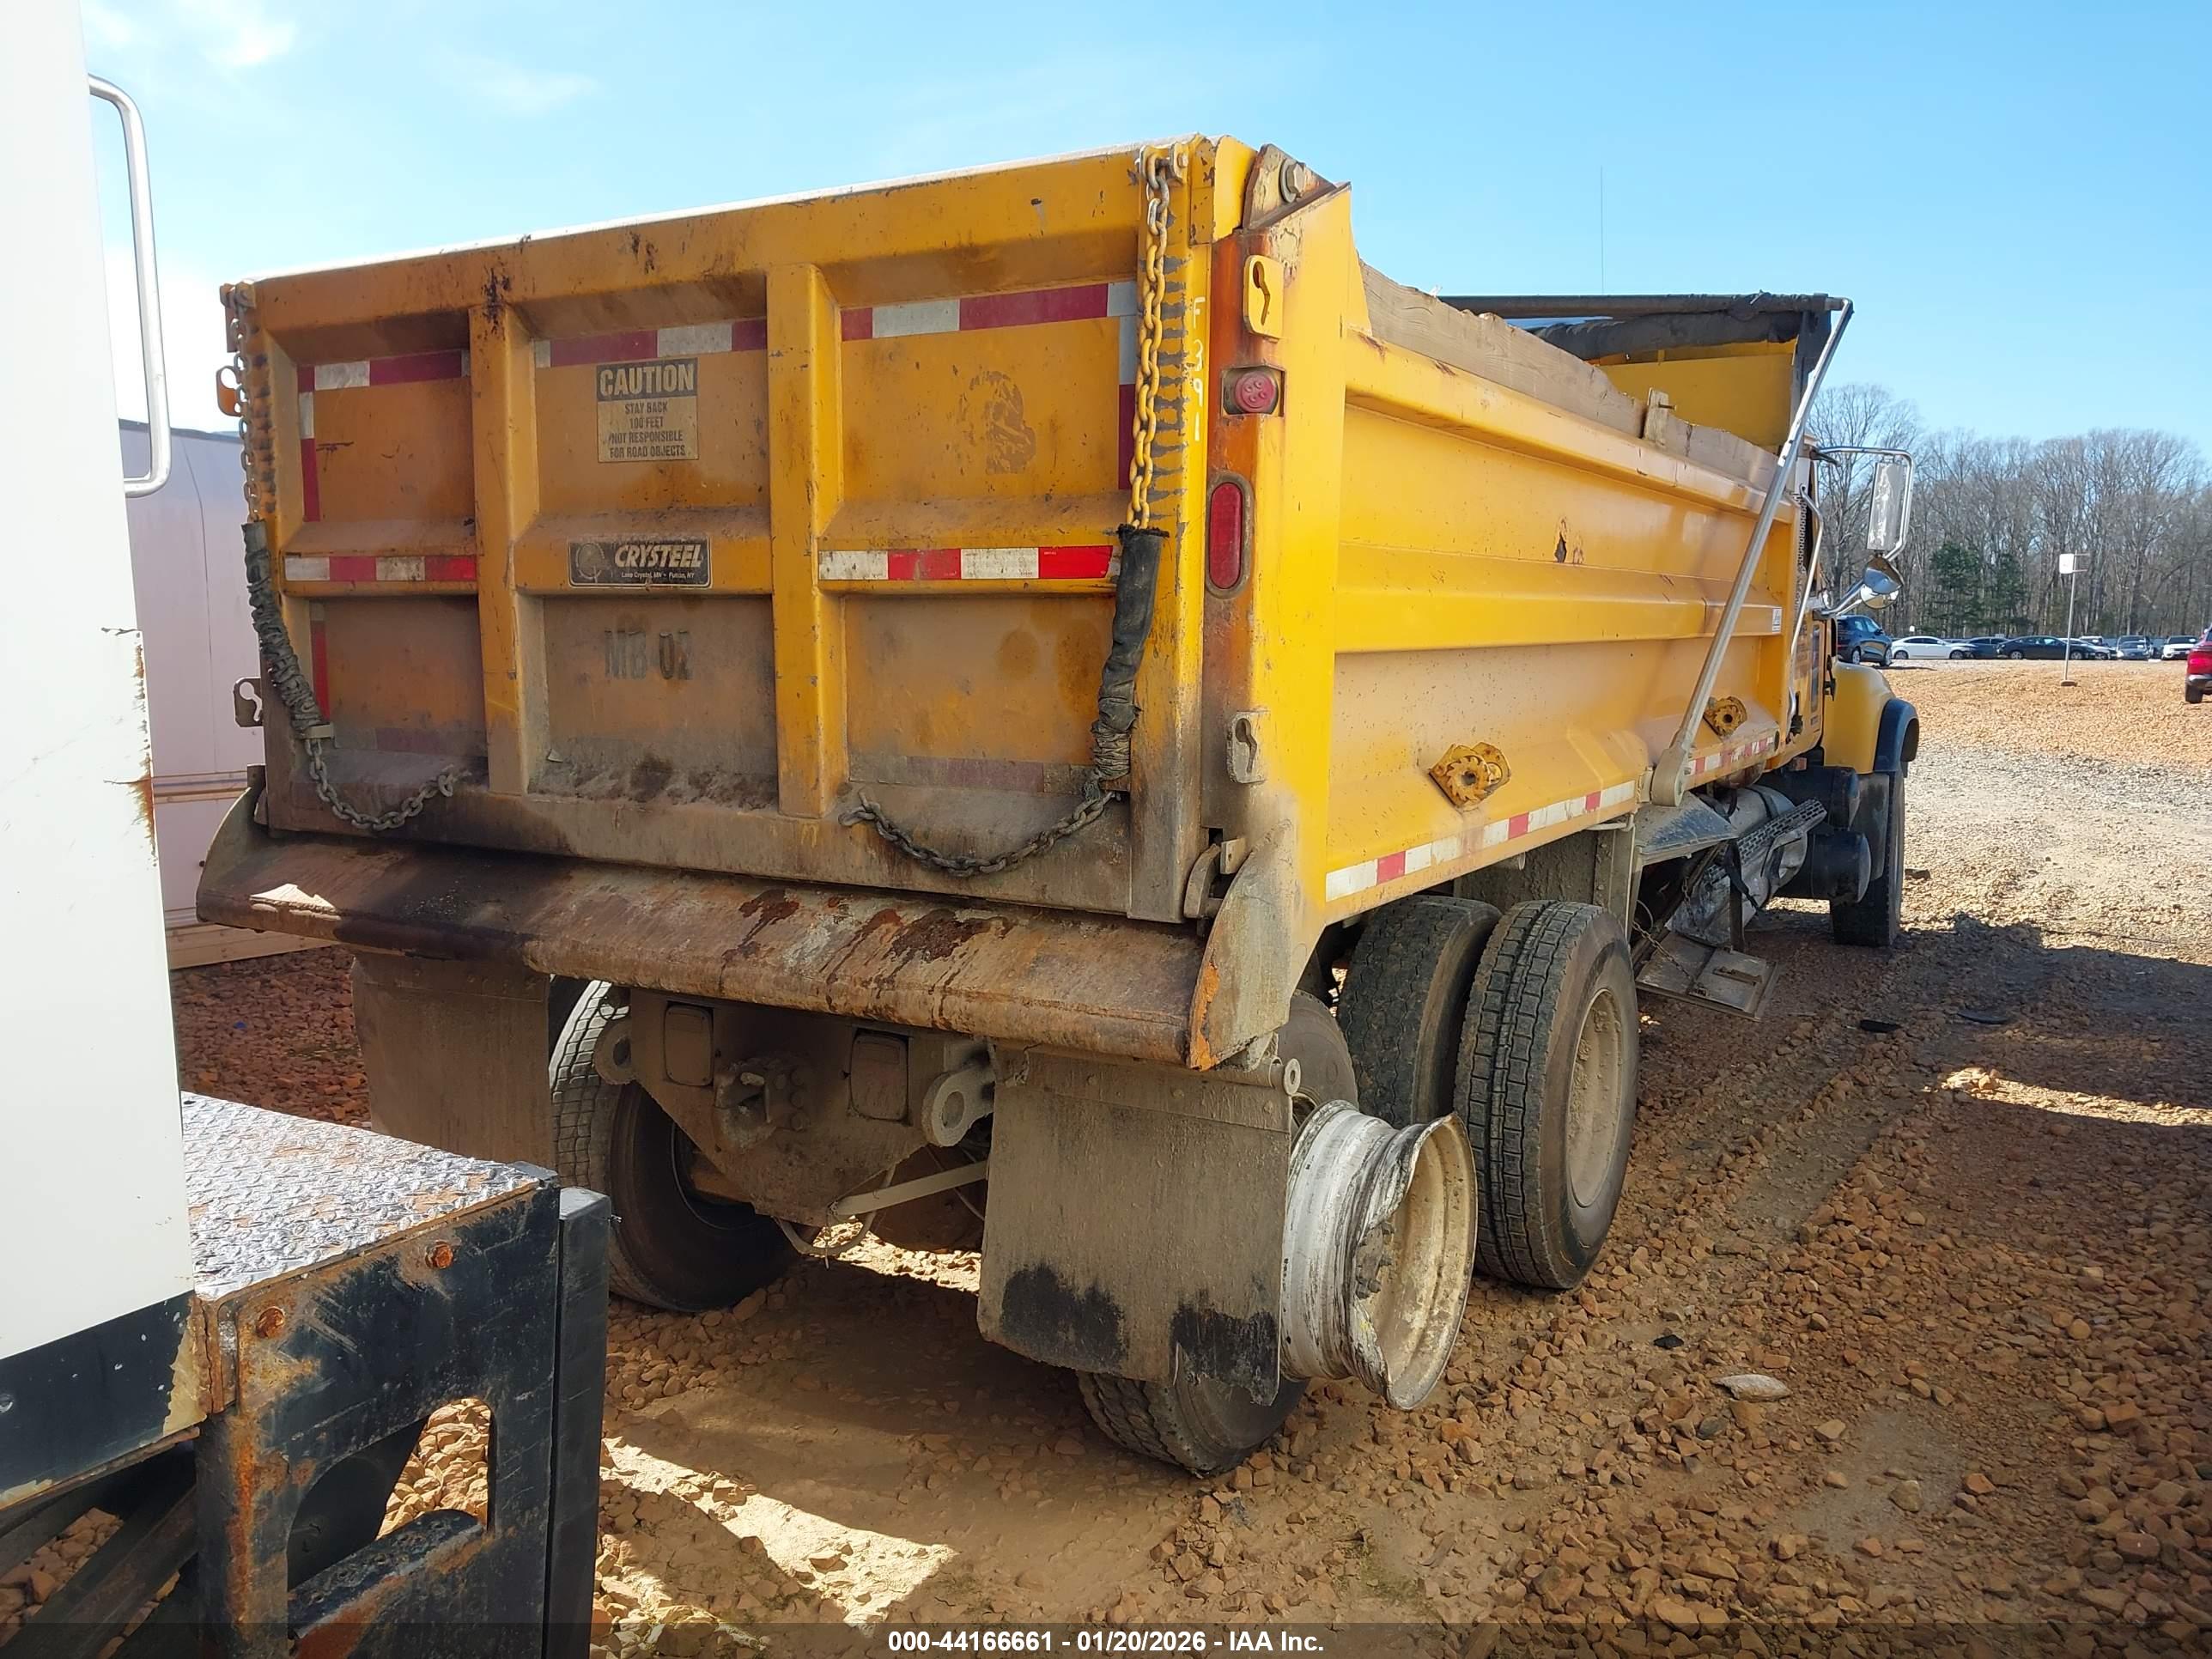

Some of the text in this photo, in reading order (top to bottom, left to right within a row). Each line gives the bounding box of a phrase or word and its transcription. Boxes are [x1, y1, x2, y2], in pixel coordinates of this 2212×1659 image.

[600, 364, 694, 397] CAUTION
[625, 401, 668, 414] STAY BACK
[629, 416, 664, 429] 100 FEET
[629, 429, 684, 443] RESPONSIBLE
[610, 444, 686, 458] FOR ROAD OBJECTS
[614, 544, 702, 568] CRYSTEEL
